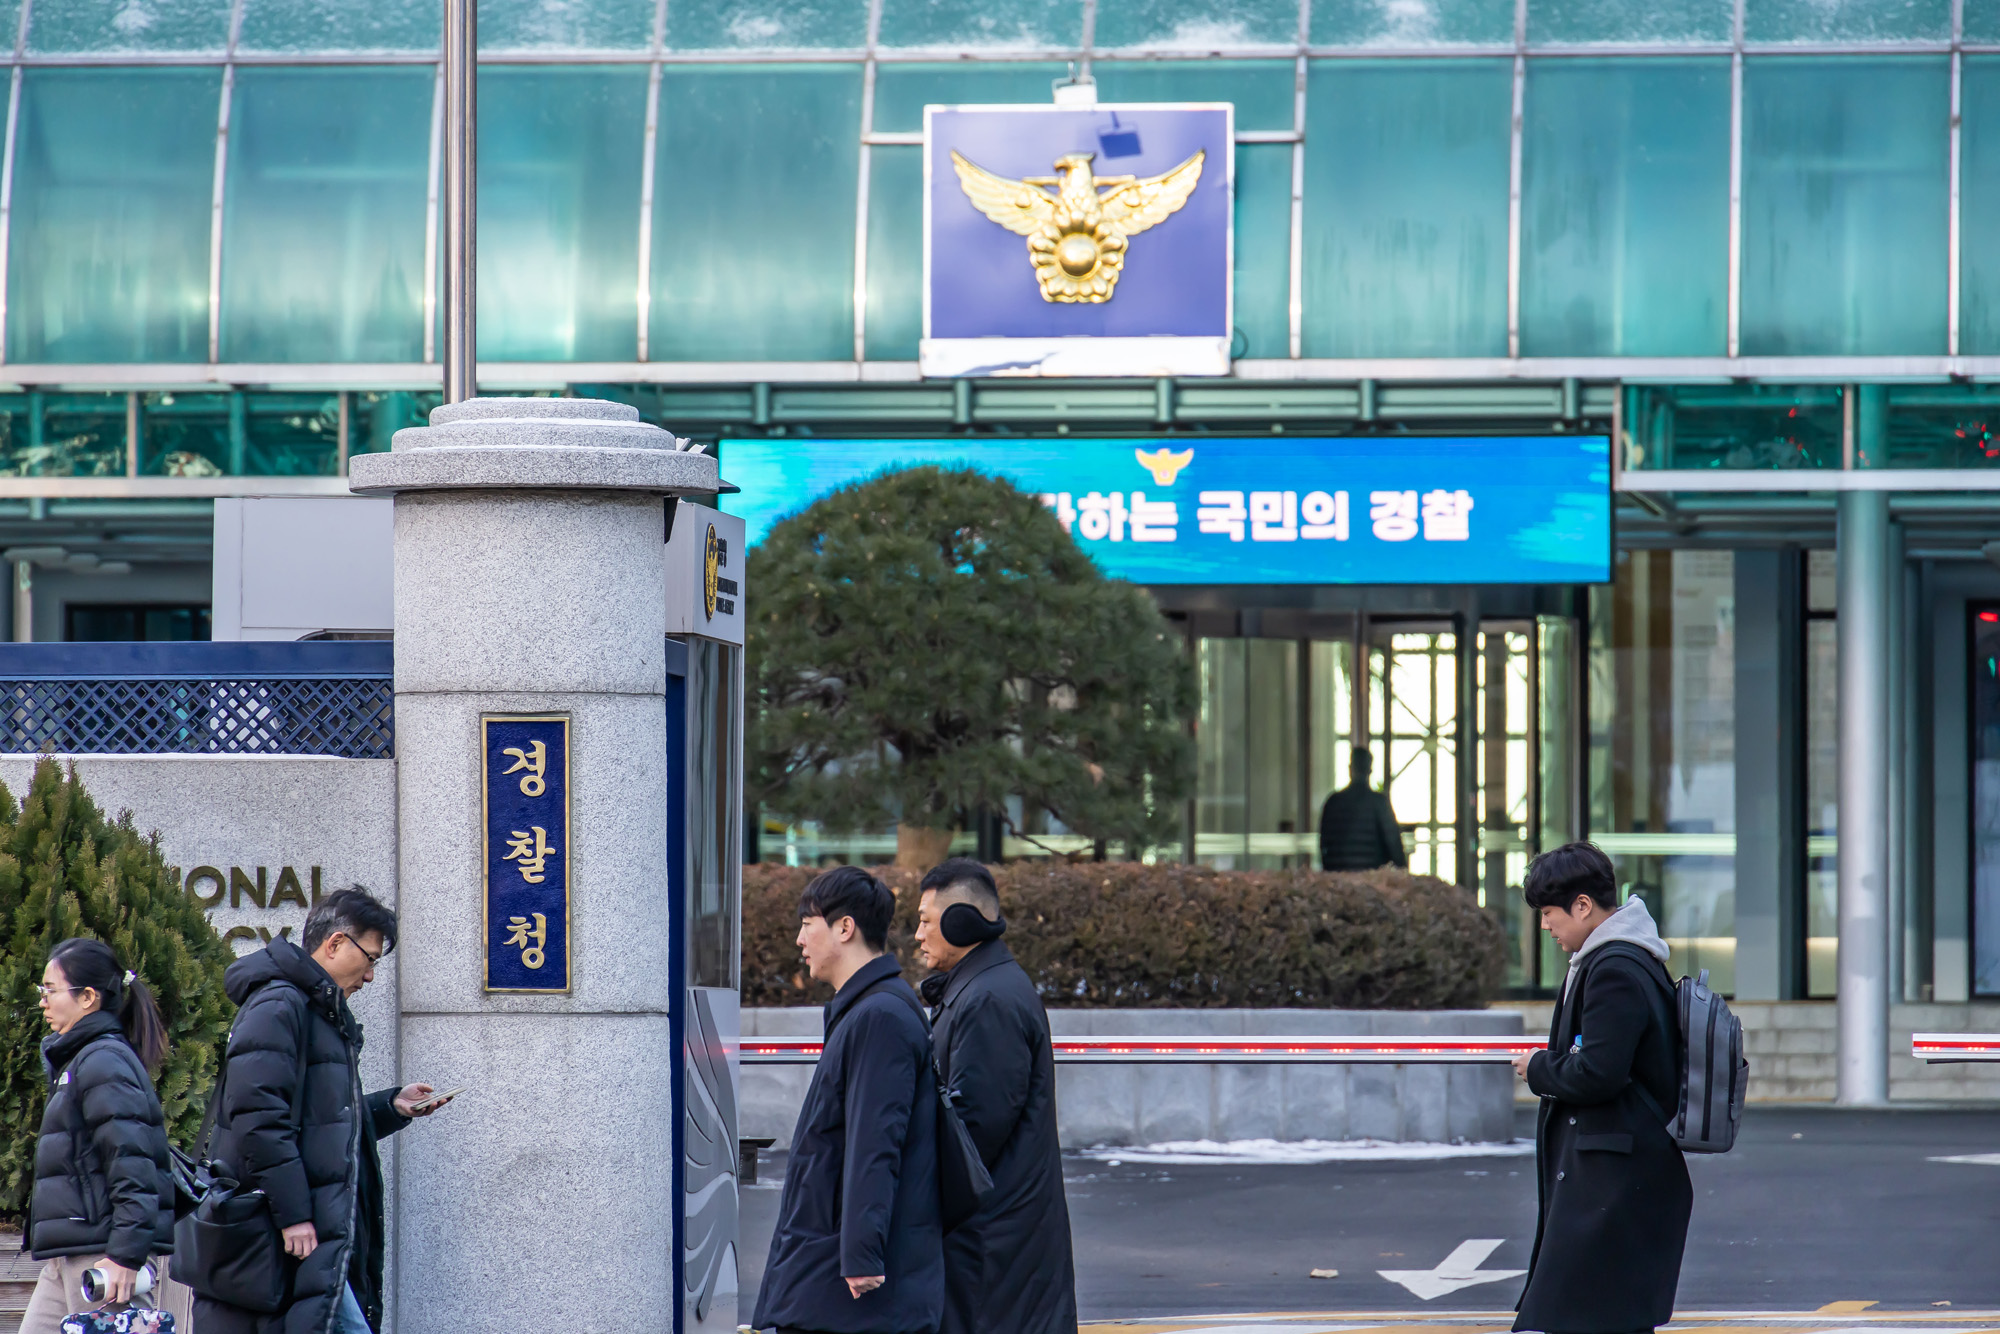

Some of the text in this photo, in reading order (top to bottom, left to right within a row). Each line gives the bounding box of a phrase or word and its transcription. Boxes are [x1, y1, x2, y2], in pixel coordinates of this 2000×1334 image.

[1197, 491, 1350, 542] 국민의
[1370, 489, 1474, 542] 경찰
[502, 740, 556, 970] 경찰청
